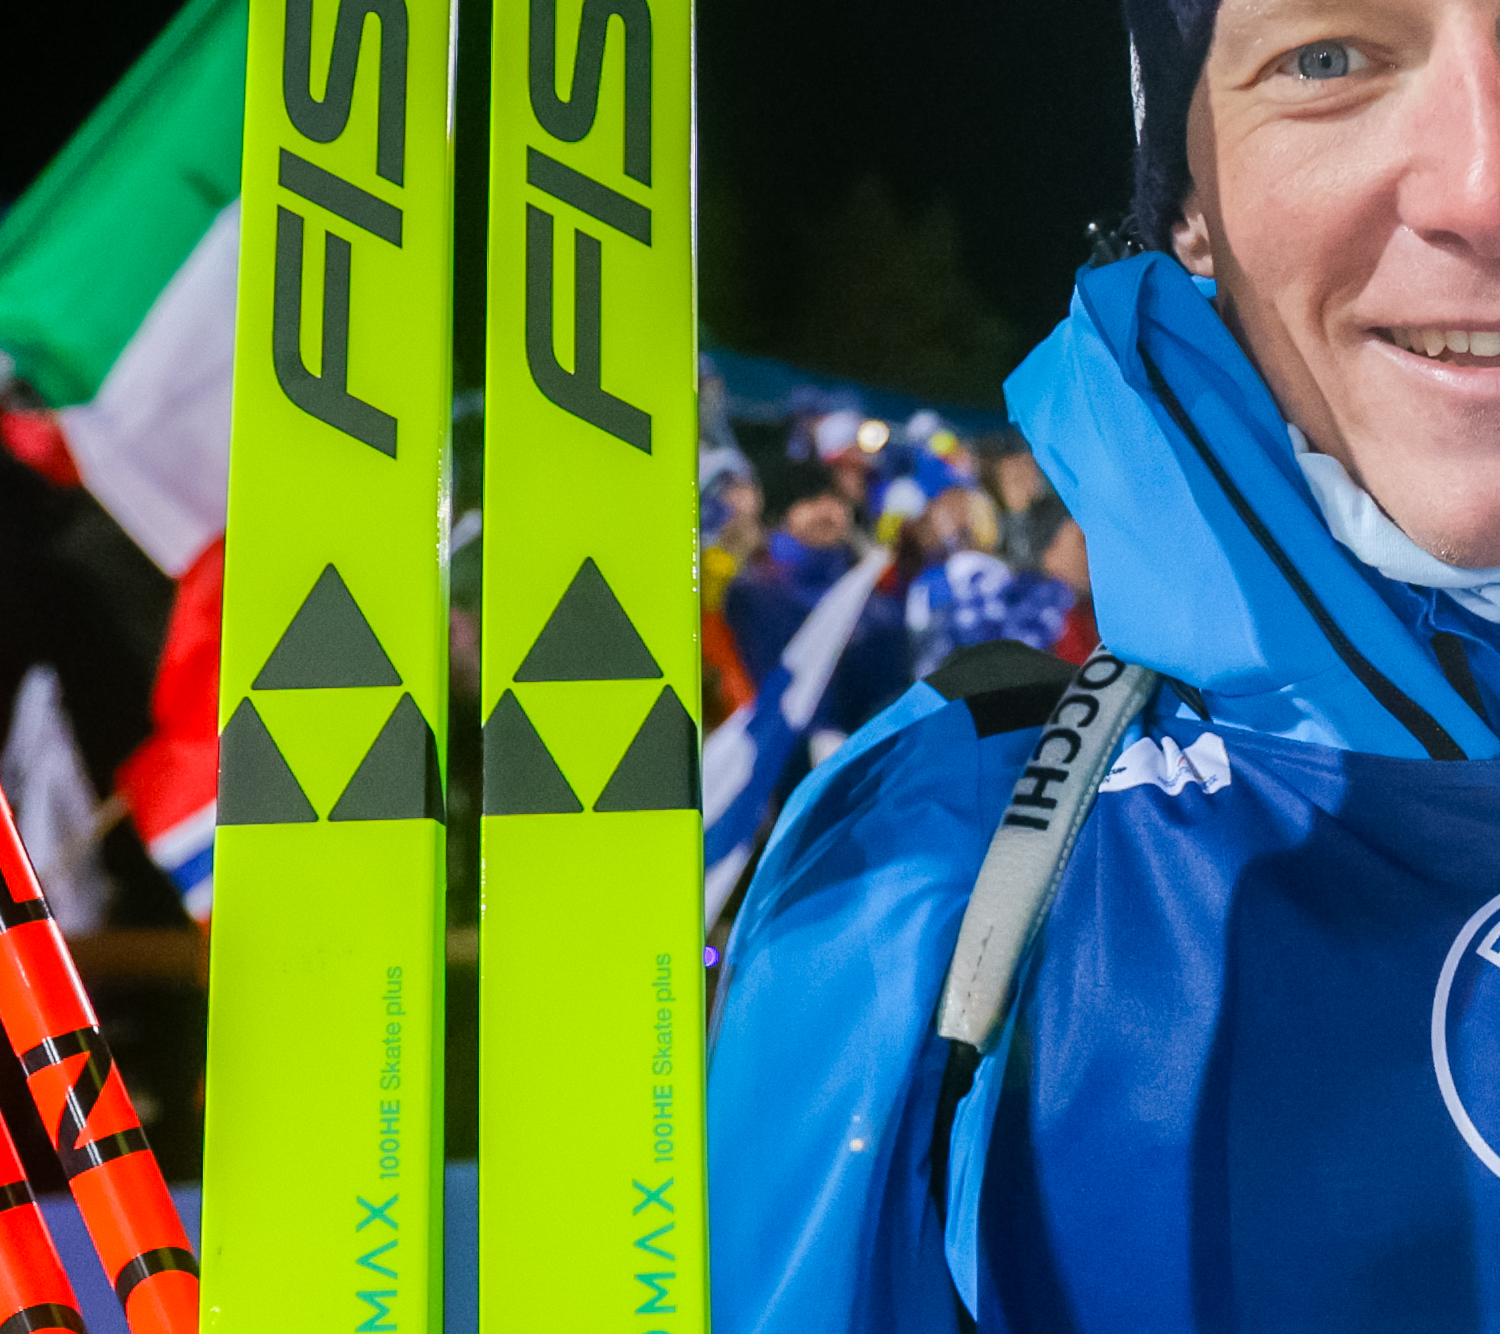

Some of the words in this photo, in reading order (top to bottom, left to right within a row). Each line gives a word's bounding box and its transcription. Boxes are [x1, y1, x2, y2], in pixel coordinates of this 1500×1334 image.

[1004, 653, 1127, 831] OCCHI
[380, 964, 405, 1016] plus
[653, 952, 677, 1004] plus
[379, 1021, 403, 1092] Skate
[651, 1006, 675, 1077] Skate
[379, 1099, 402, 1180] 100HE
[652, 1083, 675, 1164] 100HE
